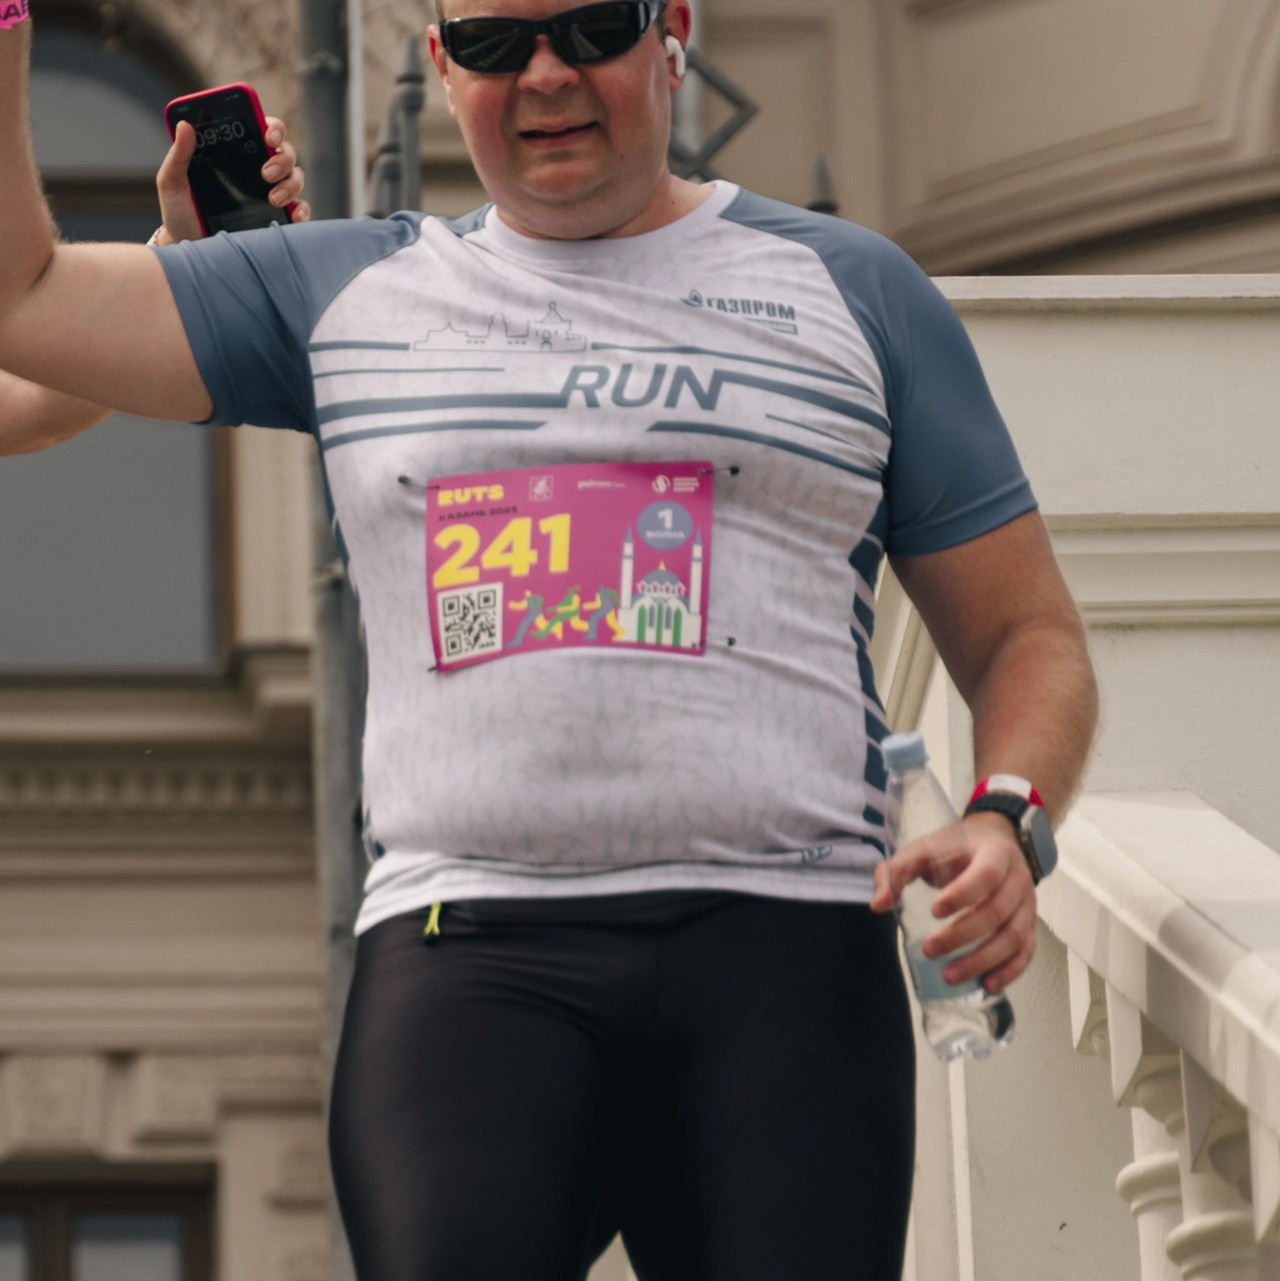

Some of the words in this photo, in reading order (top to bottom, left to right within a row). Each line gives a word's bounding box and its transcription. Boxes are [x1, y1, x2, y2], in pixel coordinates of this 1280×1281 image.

[705, 297, 796, 321] ГАЗПРОМ
[559, 362, 726, 412] RUN
[437, 484, 504, 506] RUTS
[438, 509, 487, 522] КАЗАНЬ
[489, 506, 518, 516] 2023
[657, 508, 673, 530] 1
[645, 529, 686, 540] ВОЛНА
[433, 513, 572, 590] 241
